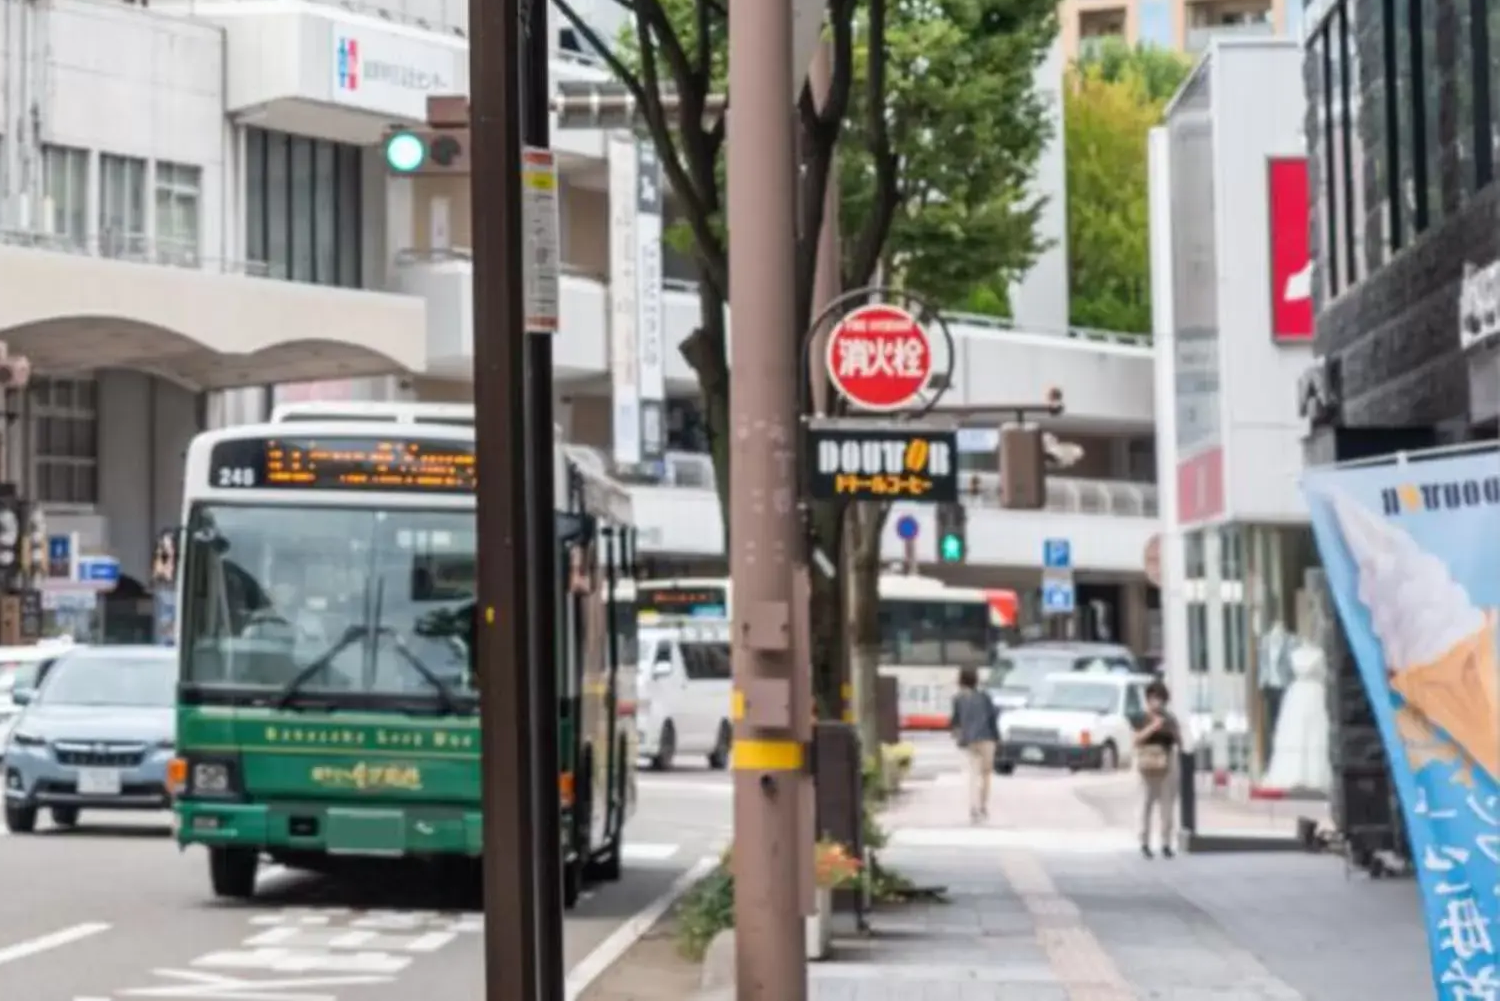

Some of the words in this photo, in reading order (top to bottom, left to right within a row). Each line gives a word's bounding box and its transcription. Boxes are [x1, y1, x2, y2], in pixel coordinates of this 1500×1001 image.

[838, 336, 925, 378] 消火栓
[818, 437, 951, 476] DOUTOR
